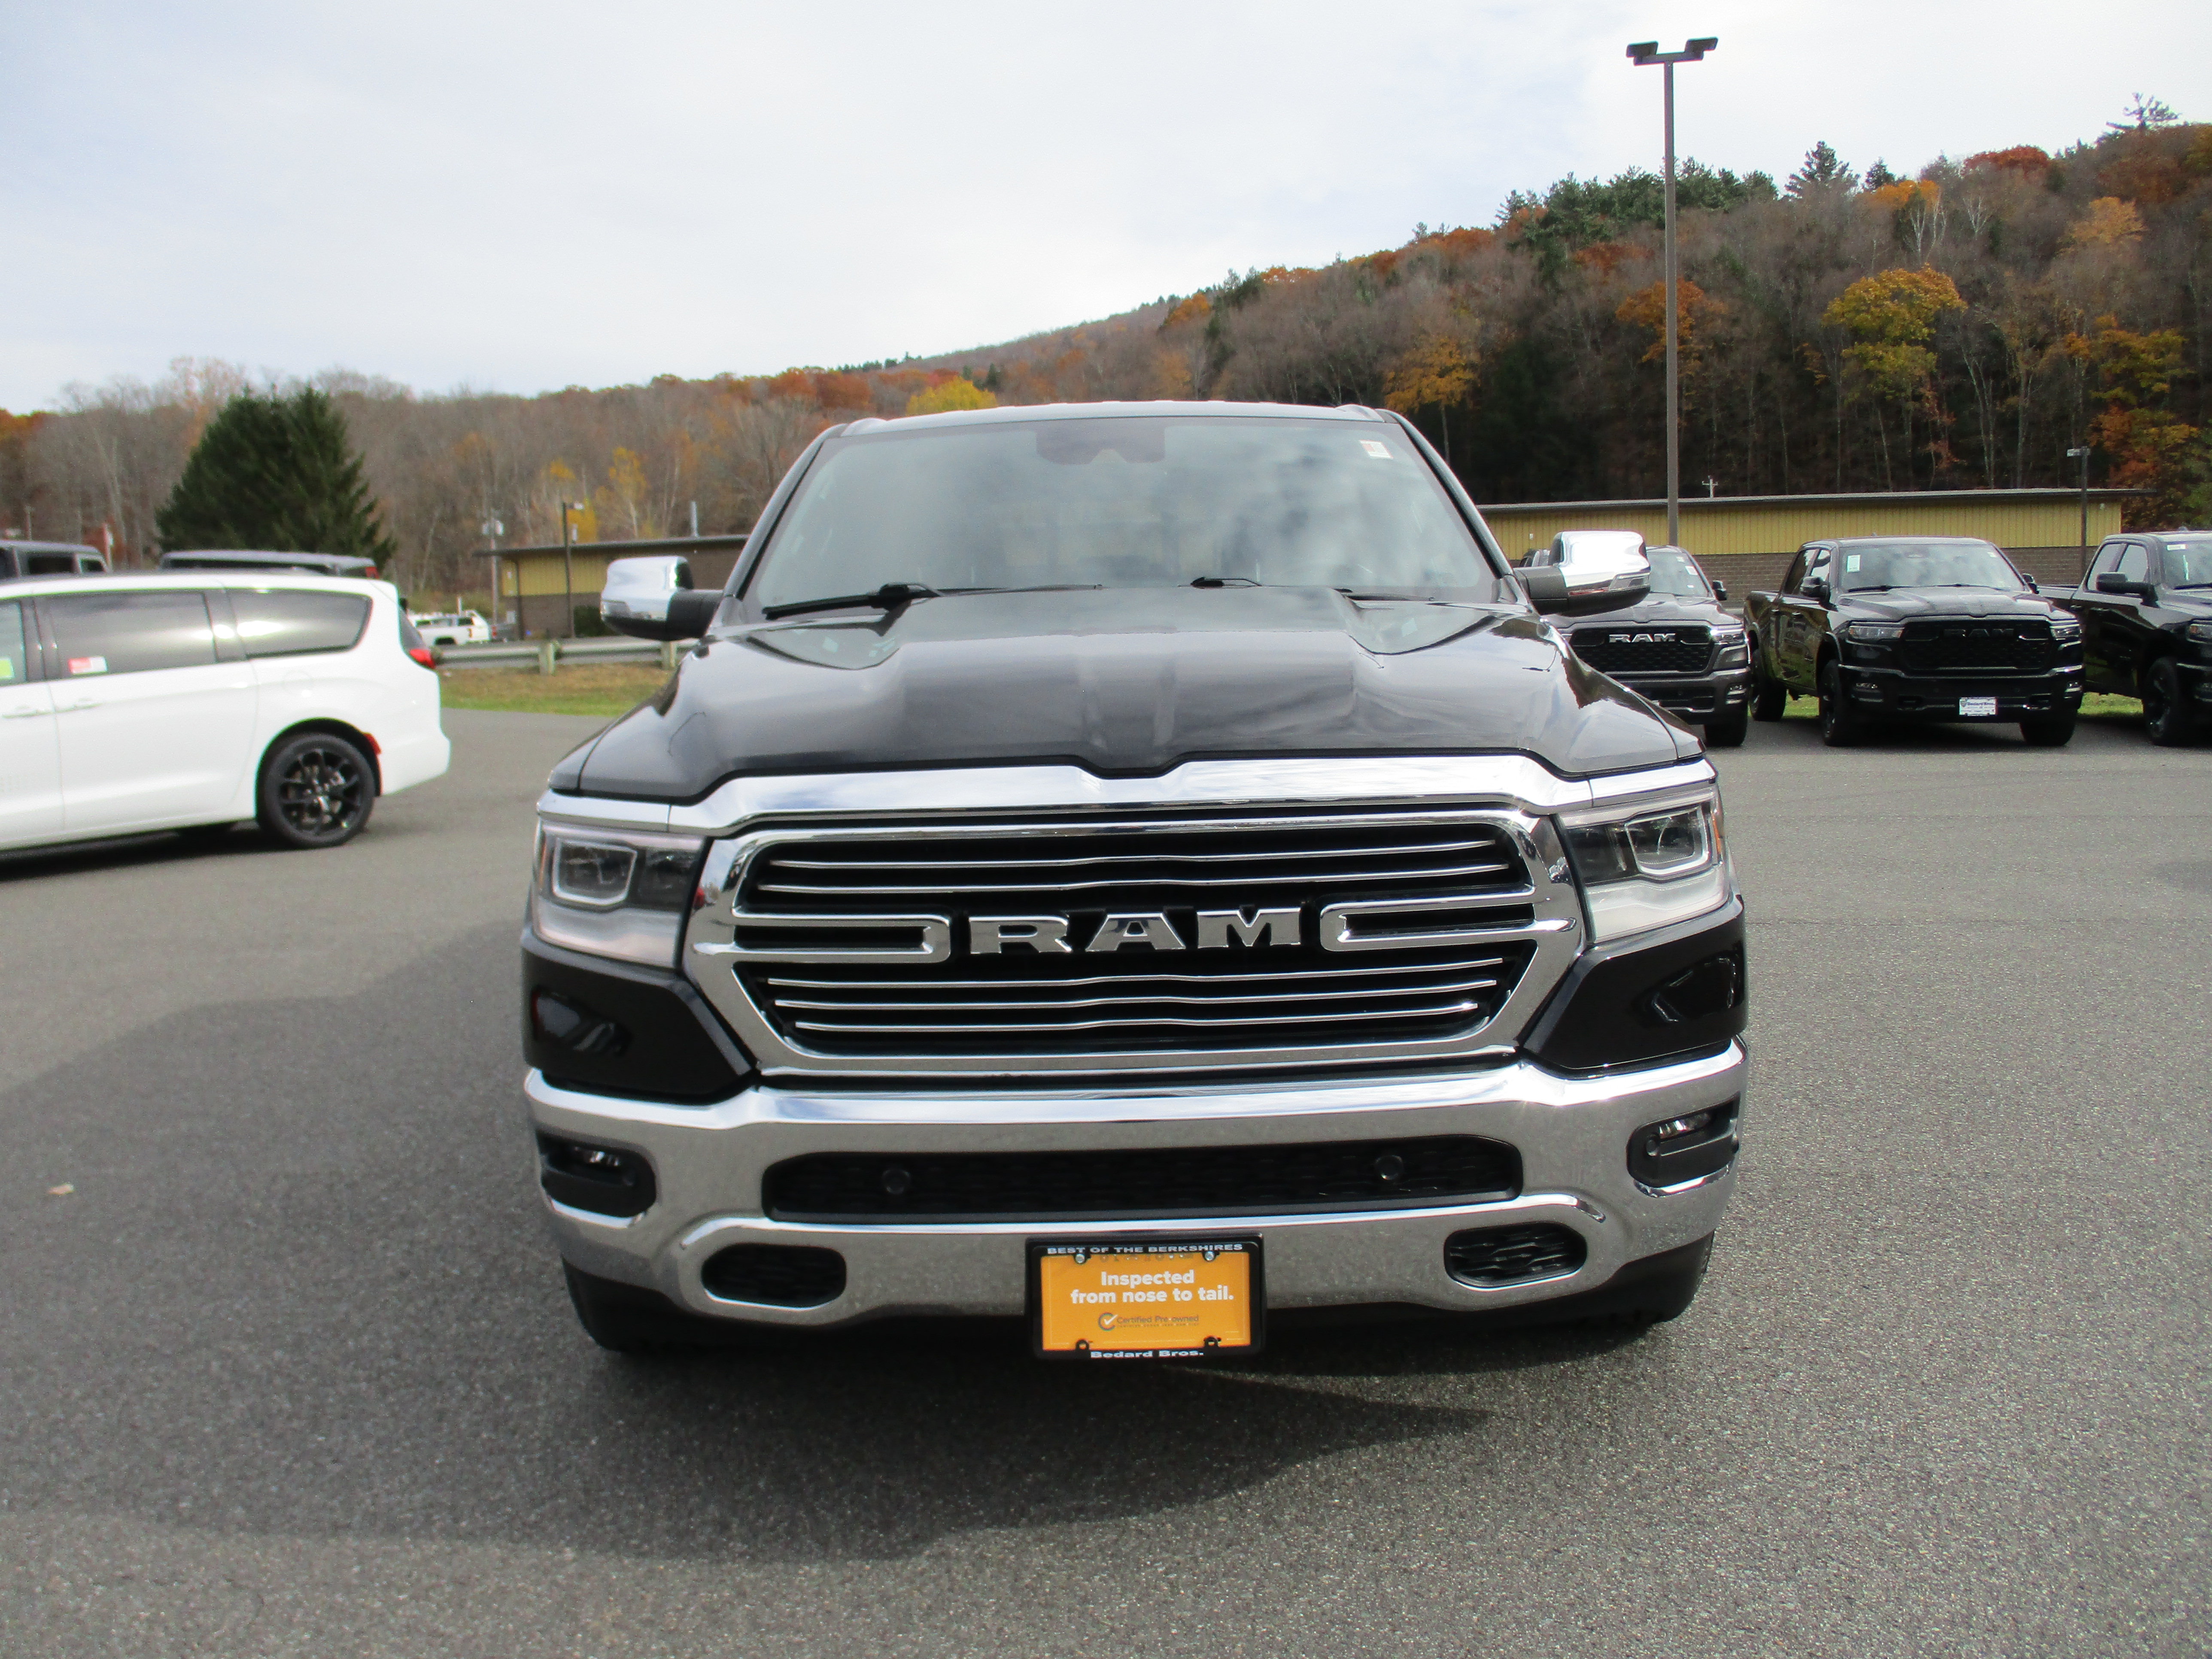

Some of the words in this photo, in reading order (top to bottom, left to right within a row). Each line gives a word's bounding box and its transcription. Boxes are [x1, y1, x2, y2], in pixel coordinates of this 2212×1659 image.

[1609, 633, 1676, 643] RAM
[1944, 629, 2014, 637] RAM
[969, 908, 1301, 954] RAM
[1148, 1244, 1243, 1252] BERKSHIRES
[1101, 1269, 1194, 1289] Inspected
[1070, 1289, 1116, 1304] from
[1122, 1290, 1167, 1302] nose
[1172, 1288, 1193, 1301] to
[1197, 1285, 1234, 1300] tail.
